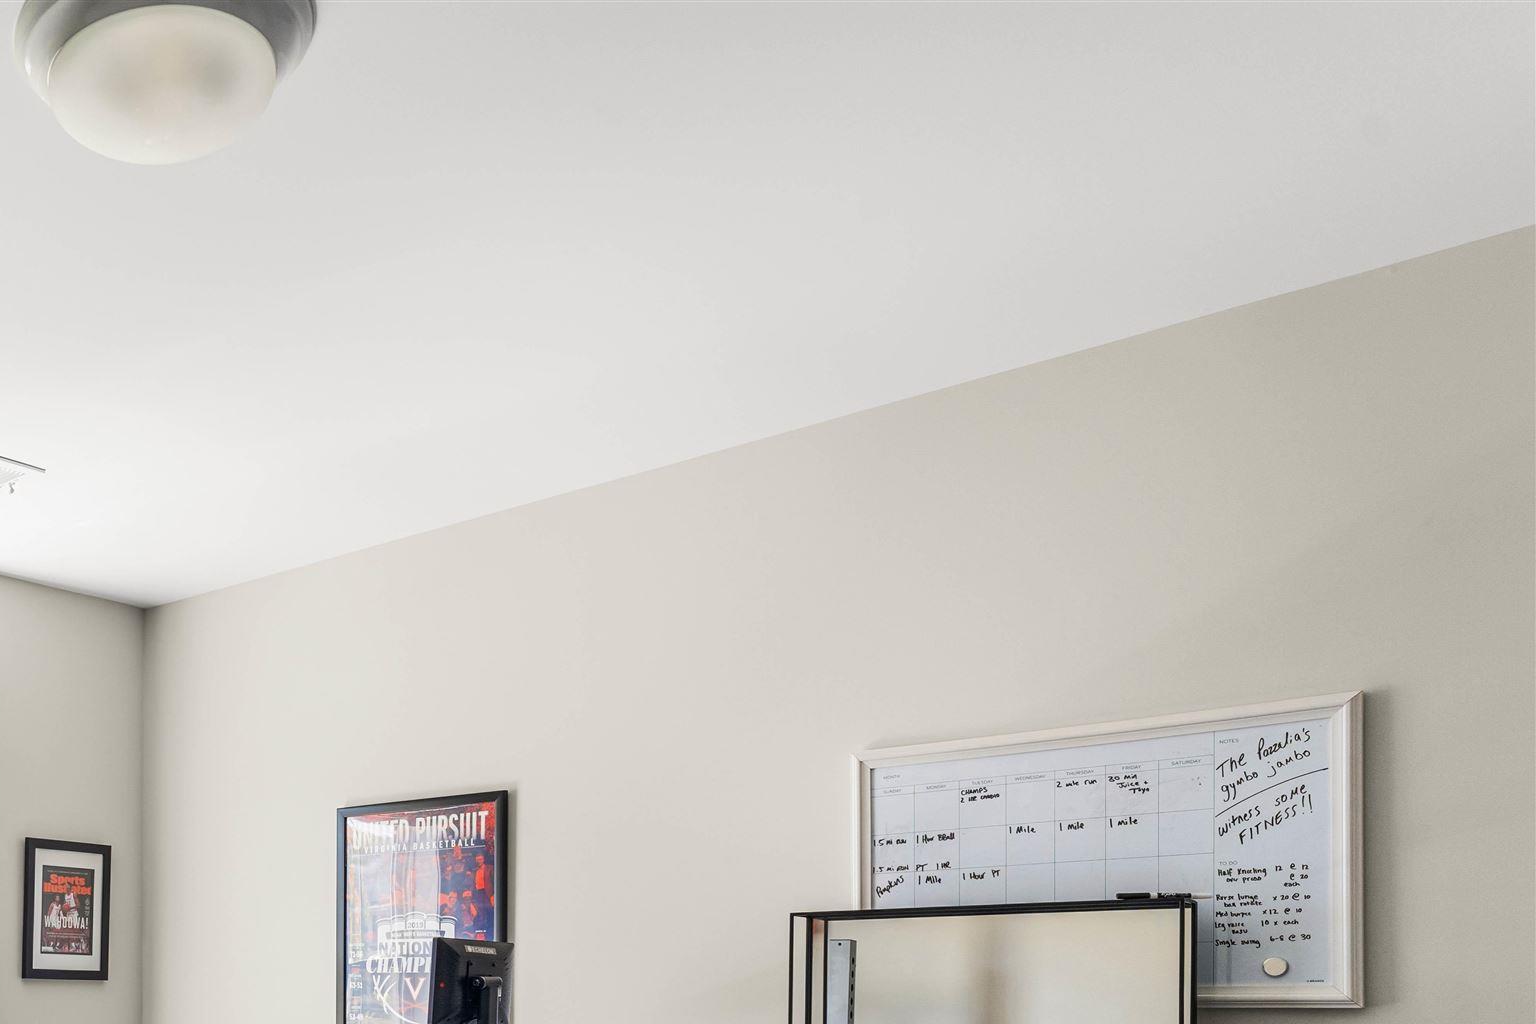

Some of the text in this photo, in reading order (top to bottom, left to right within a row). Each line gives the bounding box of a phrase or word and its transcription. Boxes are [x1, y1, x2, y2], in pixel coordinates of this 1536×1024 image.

[1171, 759, 1201, 767] SATURDAY
[1216, 753, 1247, 778] The
[1221, 749, 1311, 803] gymbo jambo
[961, 787, 988, 796] CHAMPS
[415, 810, 489, 842] PURSUIT
[364, 837, 476, 855] VIRGINIA BASKETBALL
[915, 863, 928, 872] PT
[991, 869, 1000, 877] PT
[49, 873, 86, 886] Sports
[1237, 893, 1258, 902] lunge
[378, 941, 432, 956] NATION
[365, 955, 431, 974] CHAMPI
